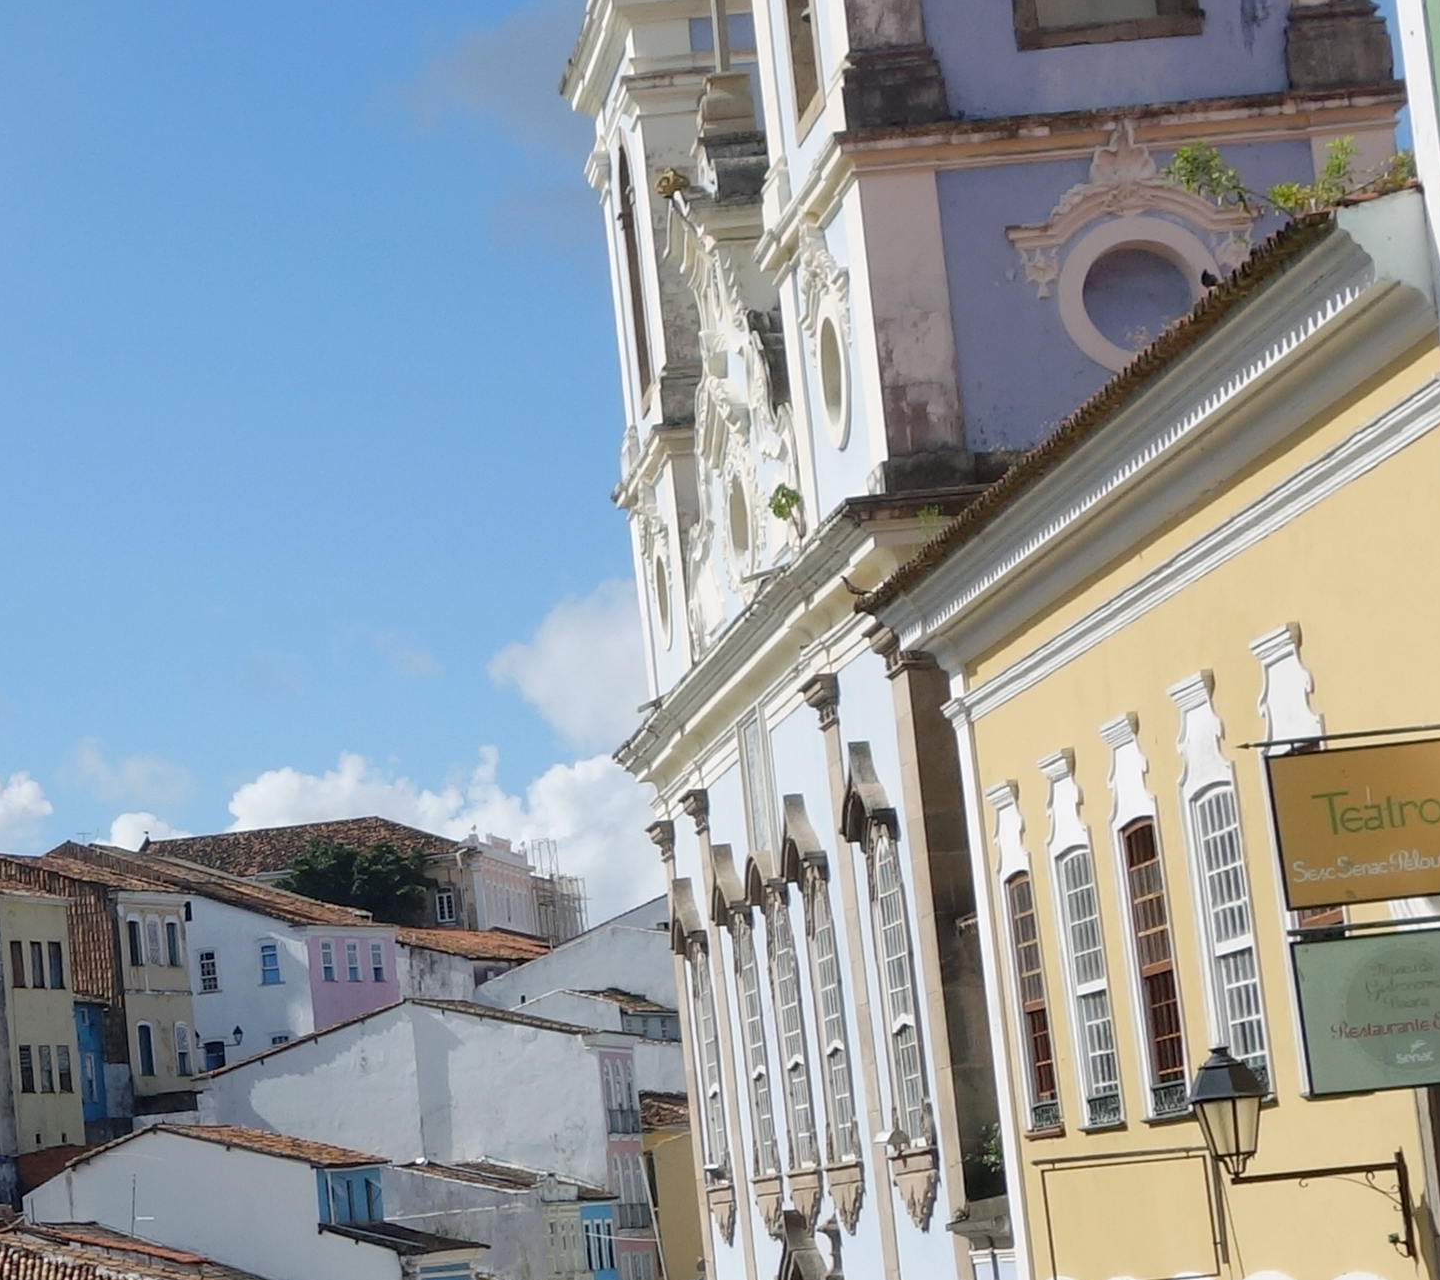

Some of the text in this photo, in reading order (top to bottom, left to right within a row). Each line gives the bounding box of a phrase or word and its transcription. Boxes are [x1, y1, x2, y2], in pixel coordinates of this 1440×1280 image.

[1292, 859, 1337, 883] Sesc
[1337, 853, 1388, 879] Senac
[1330, 1018, 1430, 1040] Restaurante
